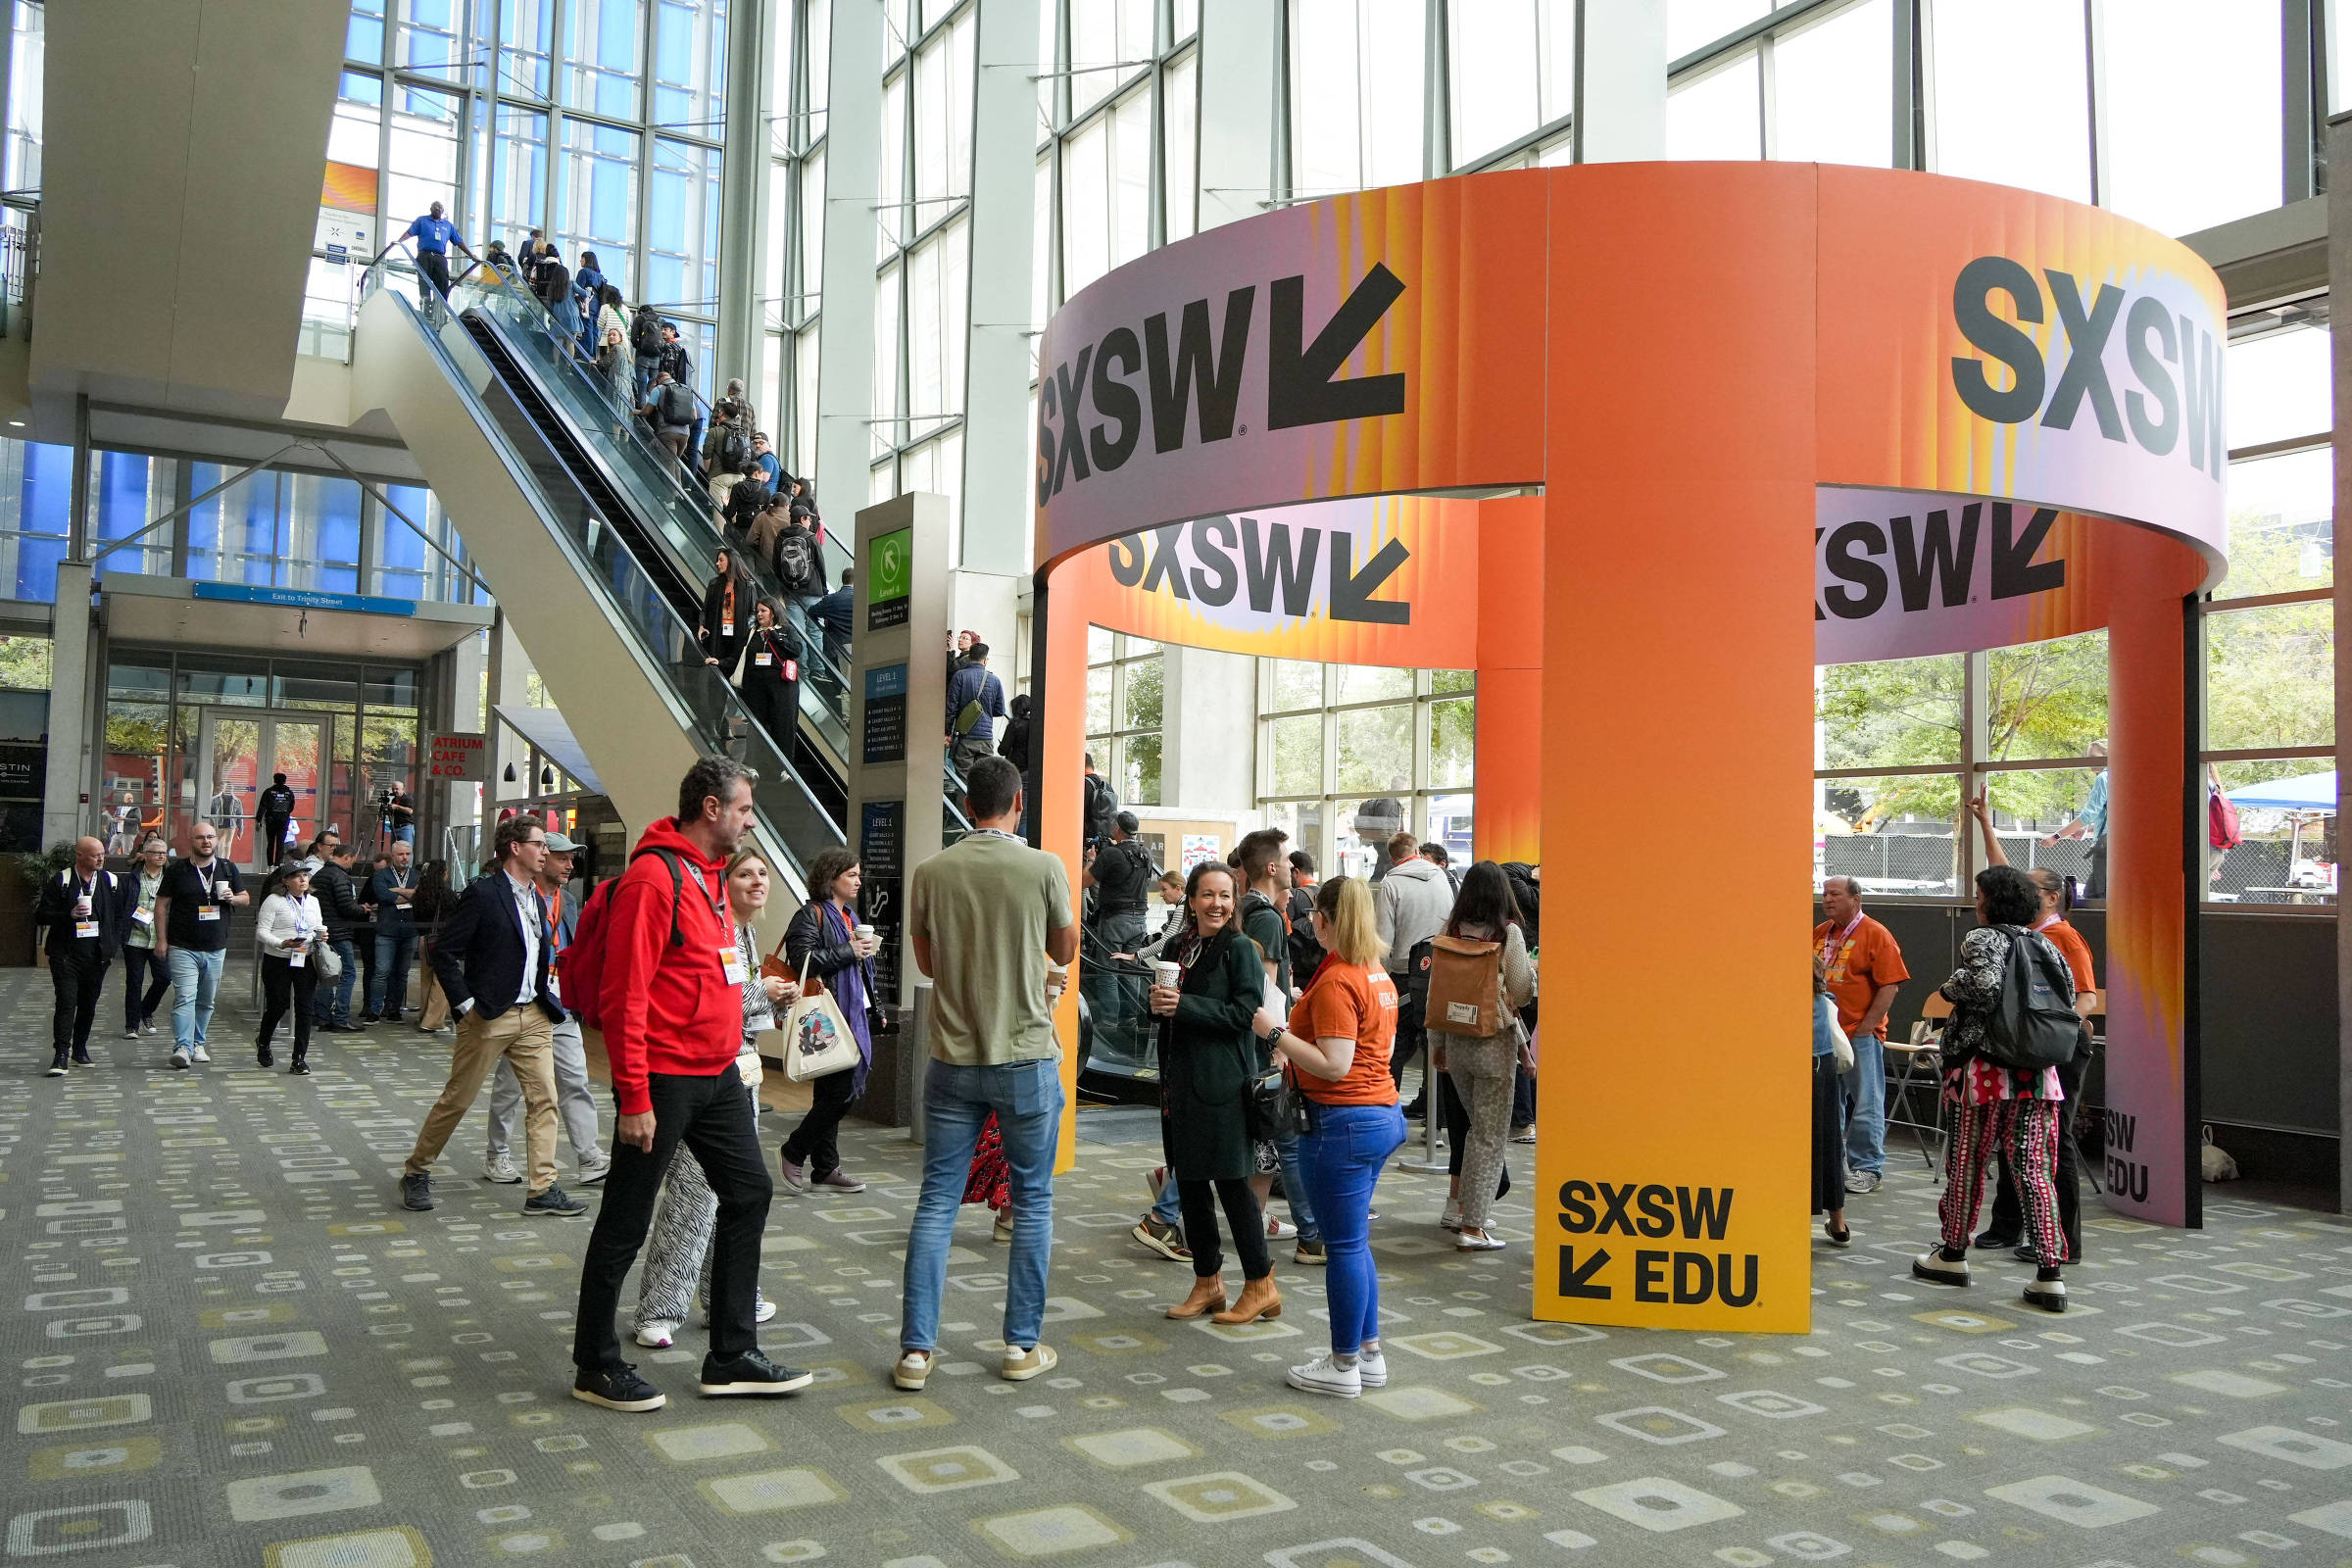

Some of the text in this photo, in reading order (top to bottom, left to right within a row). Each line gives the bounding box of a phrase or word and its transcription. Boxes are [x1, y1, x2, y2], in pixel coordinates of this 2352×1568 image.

[1951, 256, 2224, 484] SXSW
[1039, 285, 1256, 509] SXSW
[1815, 502, 1983, 620] SW
[297, 595, 319, 605] Trinity
[320, 597, 343, 606] Street
[876, 673, 892, 683] LEVEL
[432, 751, 466, 762] CAFE
[433, 737, 483, 750] ATRIUM
[432, 764, 466, 776] & CO.
[872, 817, 887, 827] LEVEL
[2107, 1153, 2148, 1203] EDU
[1558, 1180, 1734, 1240] SXSW
[1635, 1250, 1759, 1308] EDU
